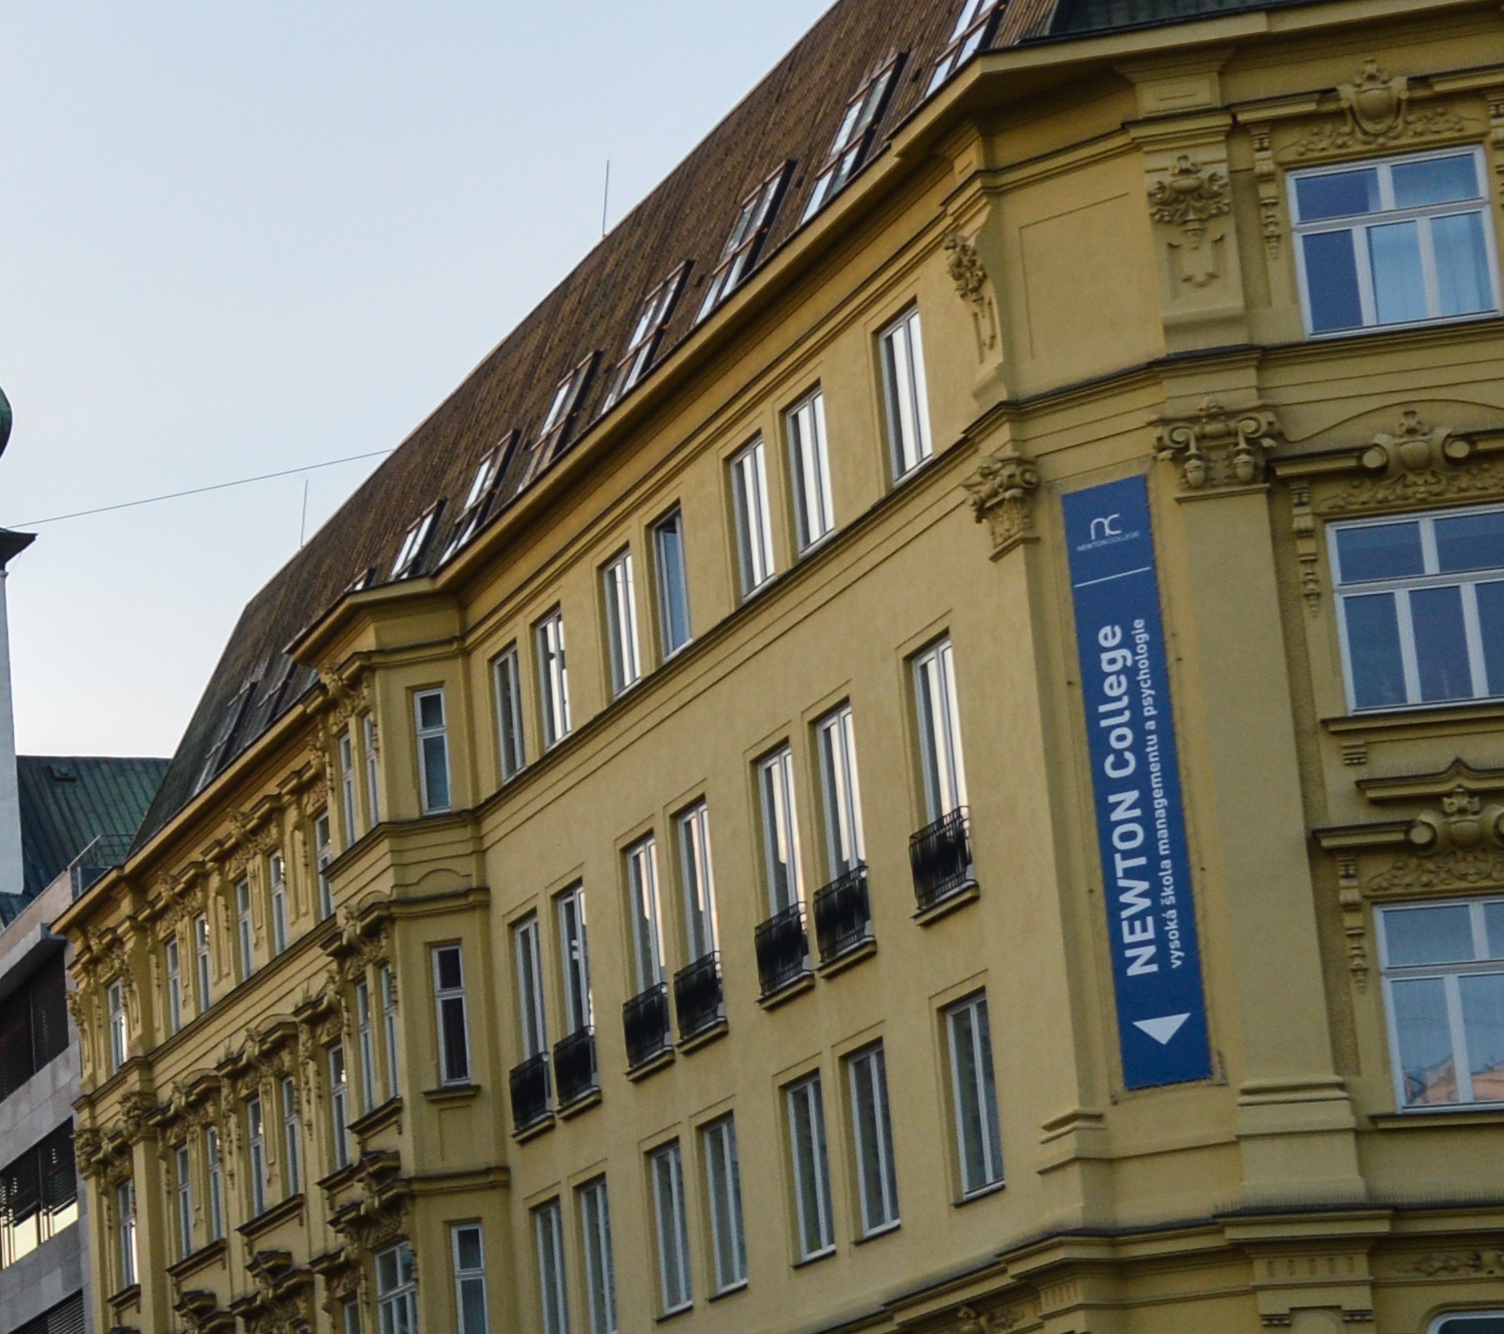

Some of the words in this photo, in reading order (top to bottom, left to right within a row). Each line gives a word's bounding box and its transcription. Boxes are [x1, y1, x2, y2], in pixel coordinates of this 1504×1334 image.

[1098, 624, 1136, 779] College
[1131, 618, 1158, 717] psychologie
[1144, 720, 1157, 731] a
[1145, 734, 1170, 855] managementu
[1107, 789, 1159, 977] NEWTON
[1158, 859, 1176, 905] škola
[1162, 908, 1185, 969] vysoká
